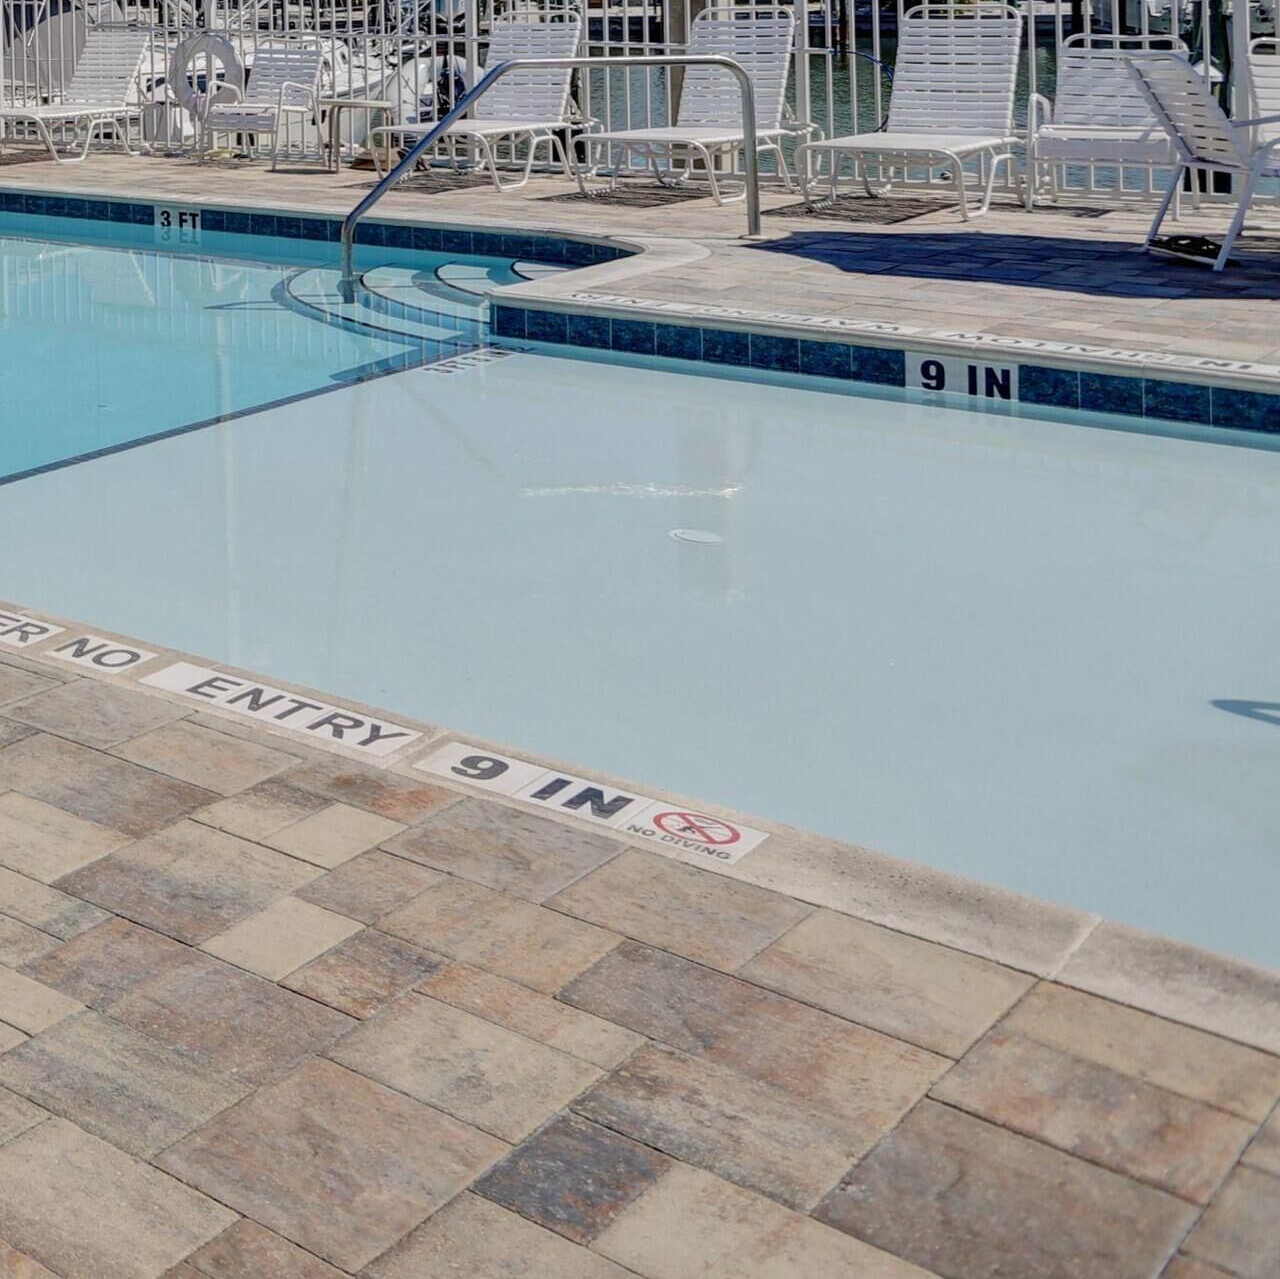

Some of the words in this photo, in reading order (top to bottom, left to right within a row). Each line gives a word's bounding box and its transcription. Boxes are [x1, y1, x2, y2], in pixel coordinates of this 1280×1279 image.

[160, 210, 171, 227] 3
[178, 212, 199, 230] FT
[920, 360, 945, 390] 9
[967, 365, 1011, 400] IN
[55, 637, 141, 668] NO
[186, 676, 410, 747] ENTRY
[450, 755, 509, 780] 9
[530, 777, 634, 820] IN
[627, 824, 656, 837] NO
[661, 834, 732, 860] DIVING
